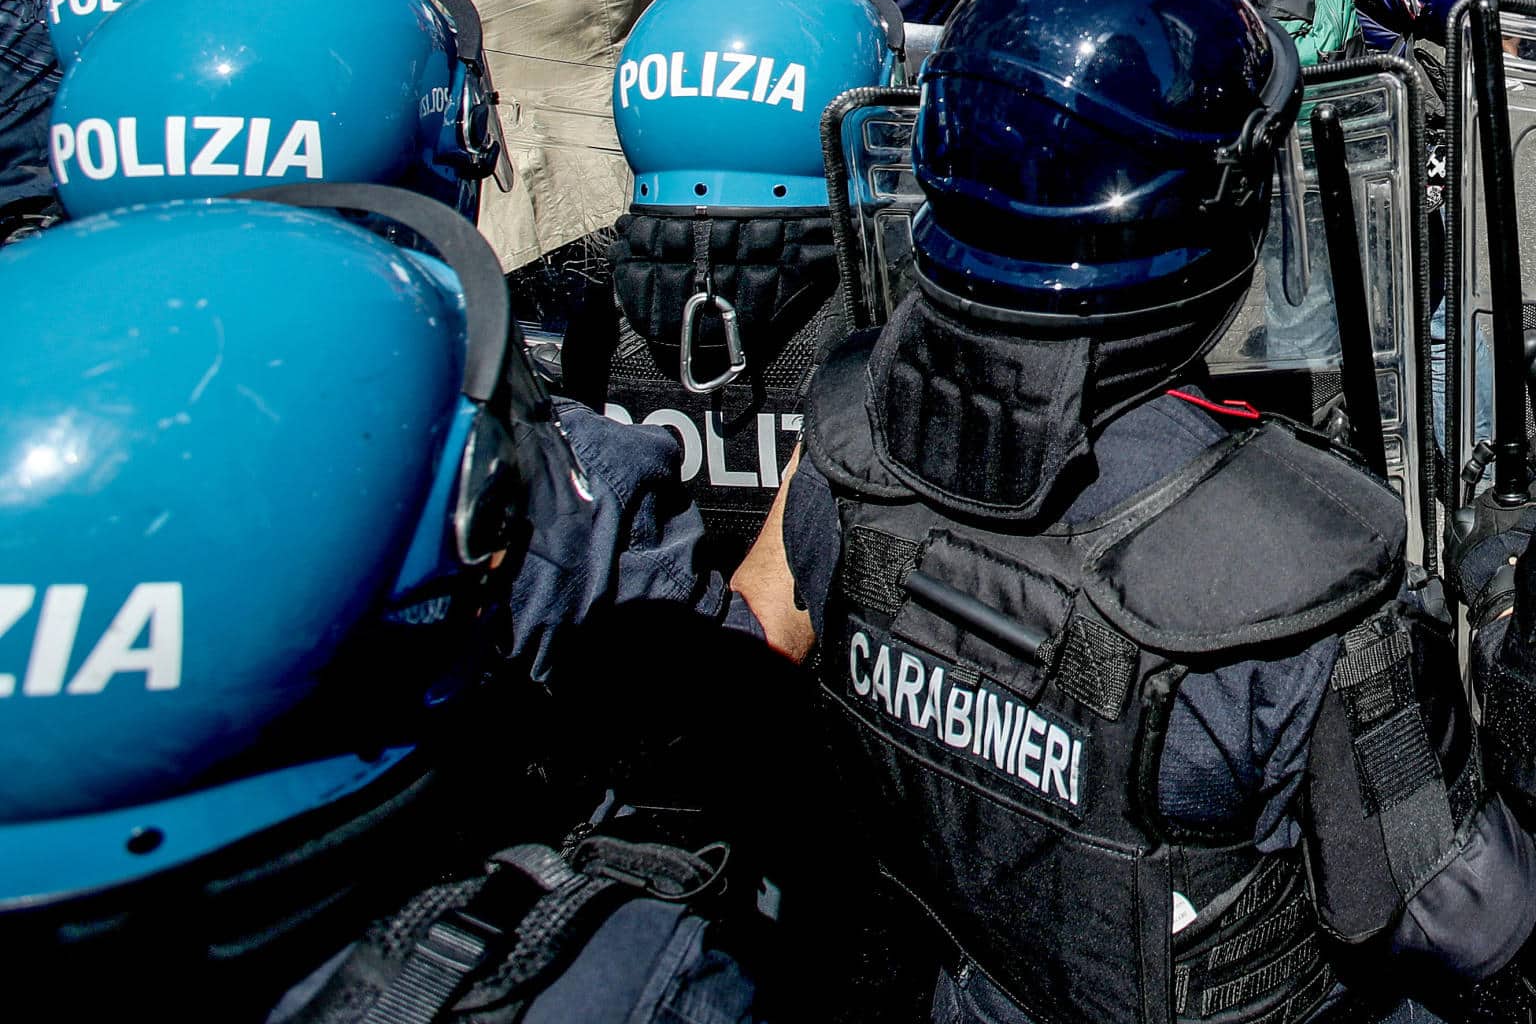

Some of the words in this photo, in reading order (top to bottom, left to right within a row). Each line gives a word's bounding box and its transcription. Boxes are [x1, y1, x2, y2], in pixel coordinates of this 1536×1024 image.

[620, 51, 806, 112] POLIZIA
[51, 116, 324, 184] POLIZIA
[850, 631, 1082, 805] CARABINIERI
